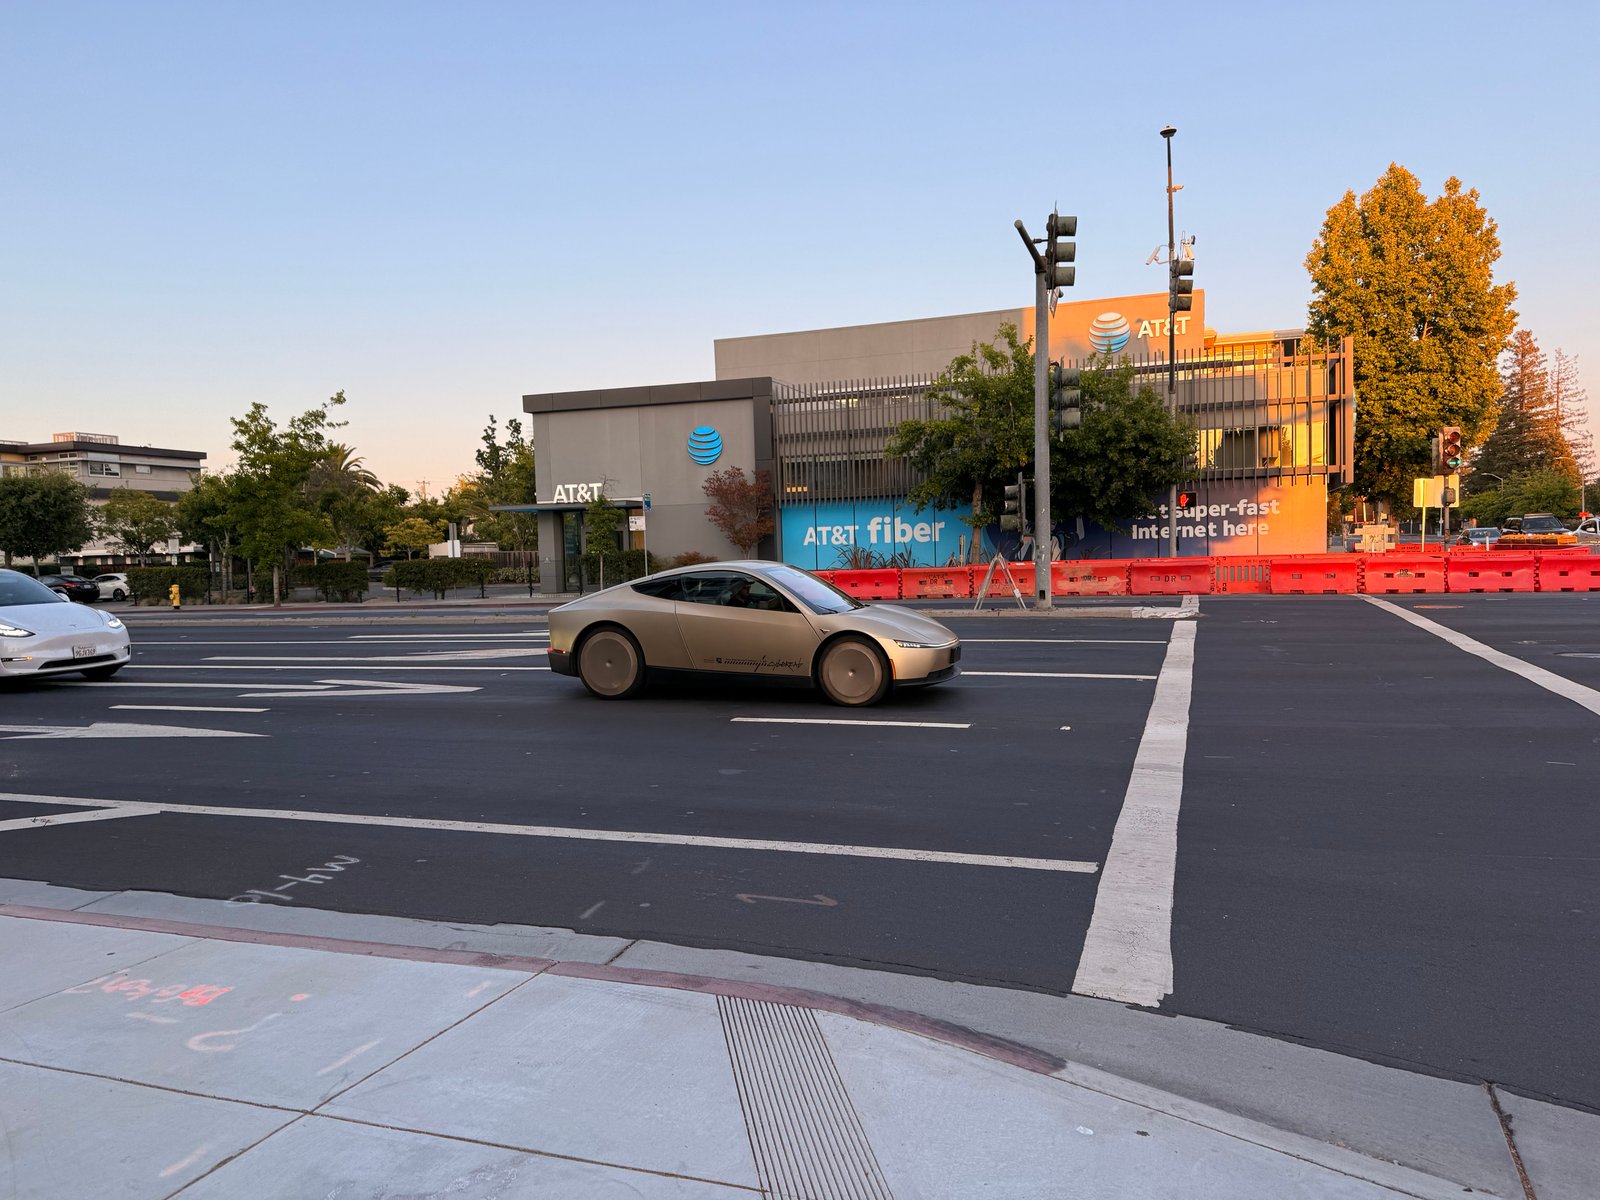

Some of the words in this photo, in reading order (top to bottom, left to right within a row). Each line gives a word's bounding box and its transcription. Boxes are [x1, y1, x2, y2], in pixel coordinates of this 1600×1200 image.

[1138, 316, 1191, 339] AT&T
[553, 483, 602, 504] AT&T
[1175, 498, 1280, 521] super-fast
[803, 525, 859, 546] AT&T
[867, 516, 945, 544] fiber
[1132, 521, 1217, 540] Internet
[1223, 520, 1270, 537] here
